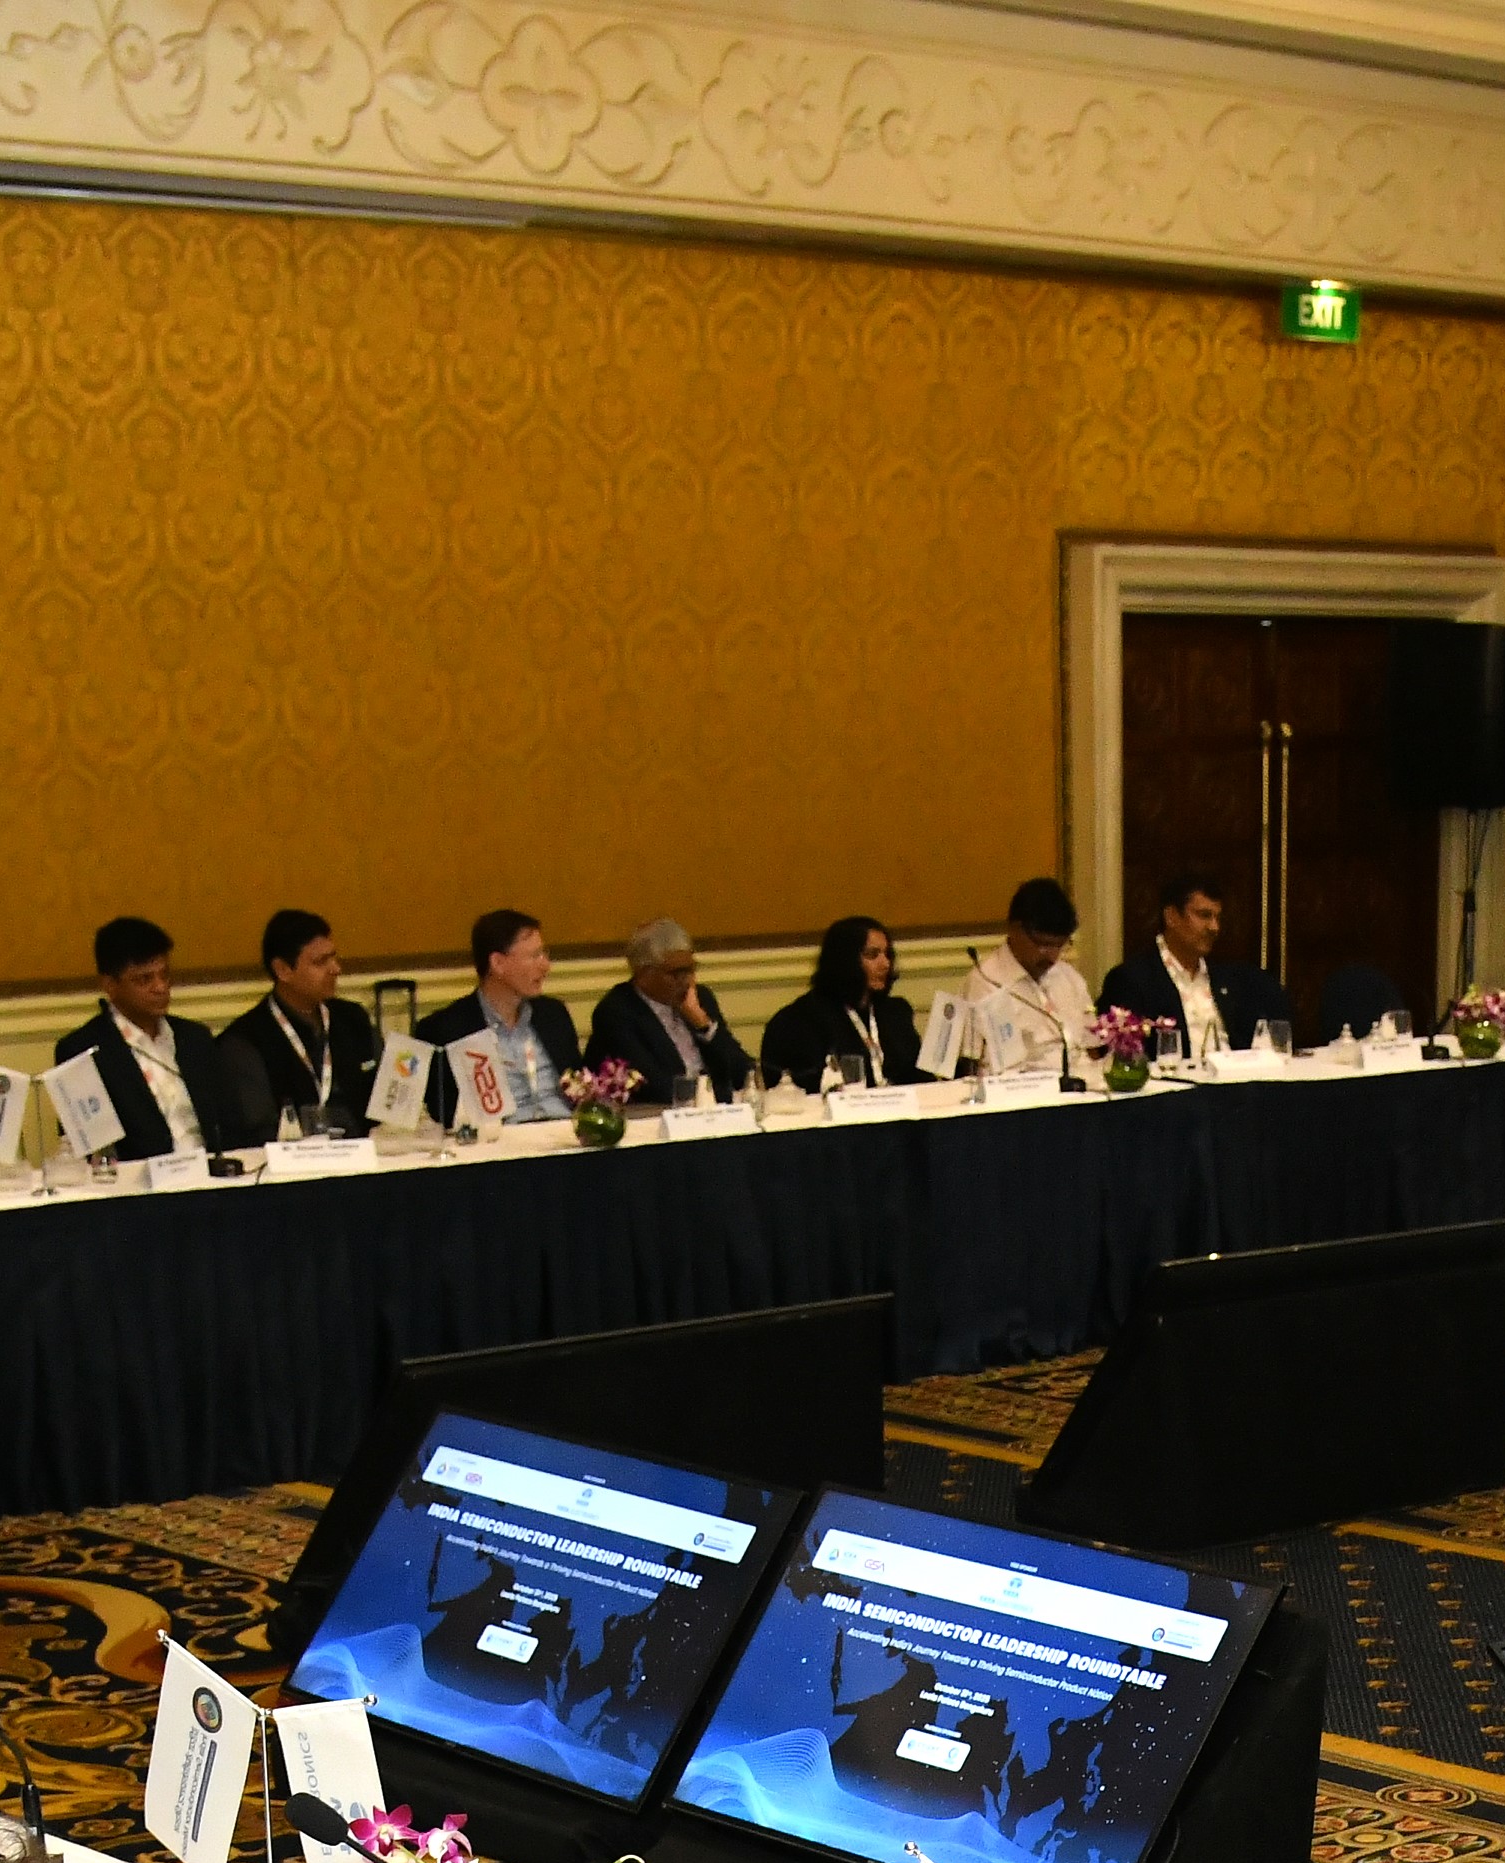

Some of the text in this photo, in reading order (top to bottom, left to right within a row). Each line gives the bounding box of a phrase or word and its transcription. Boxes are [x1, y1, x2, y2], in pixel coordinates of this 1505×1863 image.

[1298, 293, 1346, 329] EXIT
[427, 1502, 459, 1524] INDIA
[460, 1512, 556, 1549] SEMICONDUCTOR
[554, 1537, 624, 1567] LEADERSHIP
[622, 1557, 703, 1590] ROUNDTABLE
[822, 1592, 1167, 1691] INDIA SEMICONDUCTOR LEADERSHIP ROUNDTABLE
